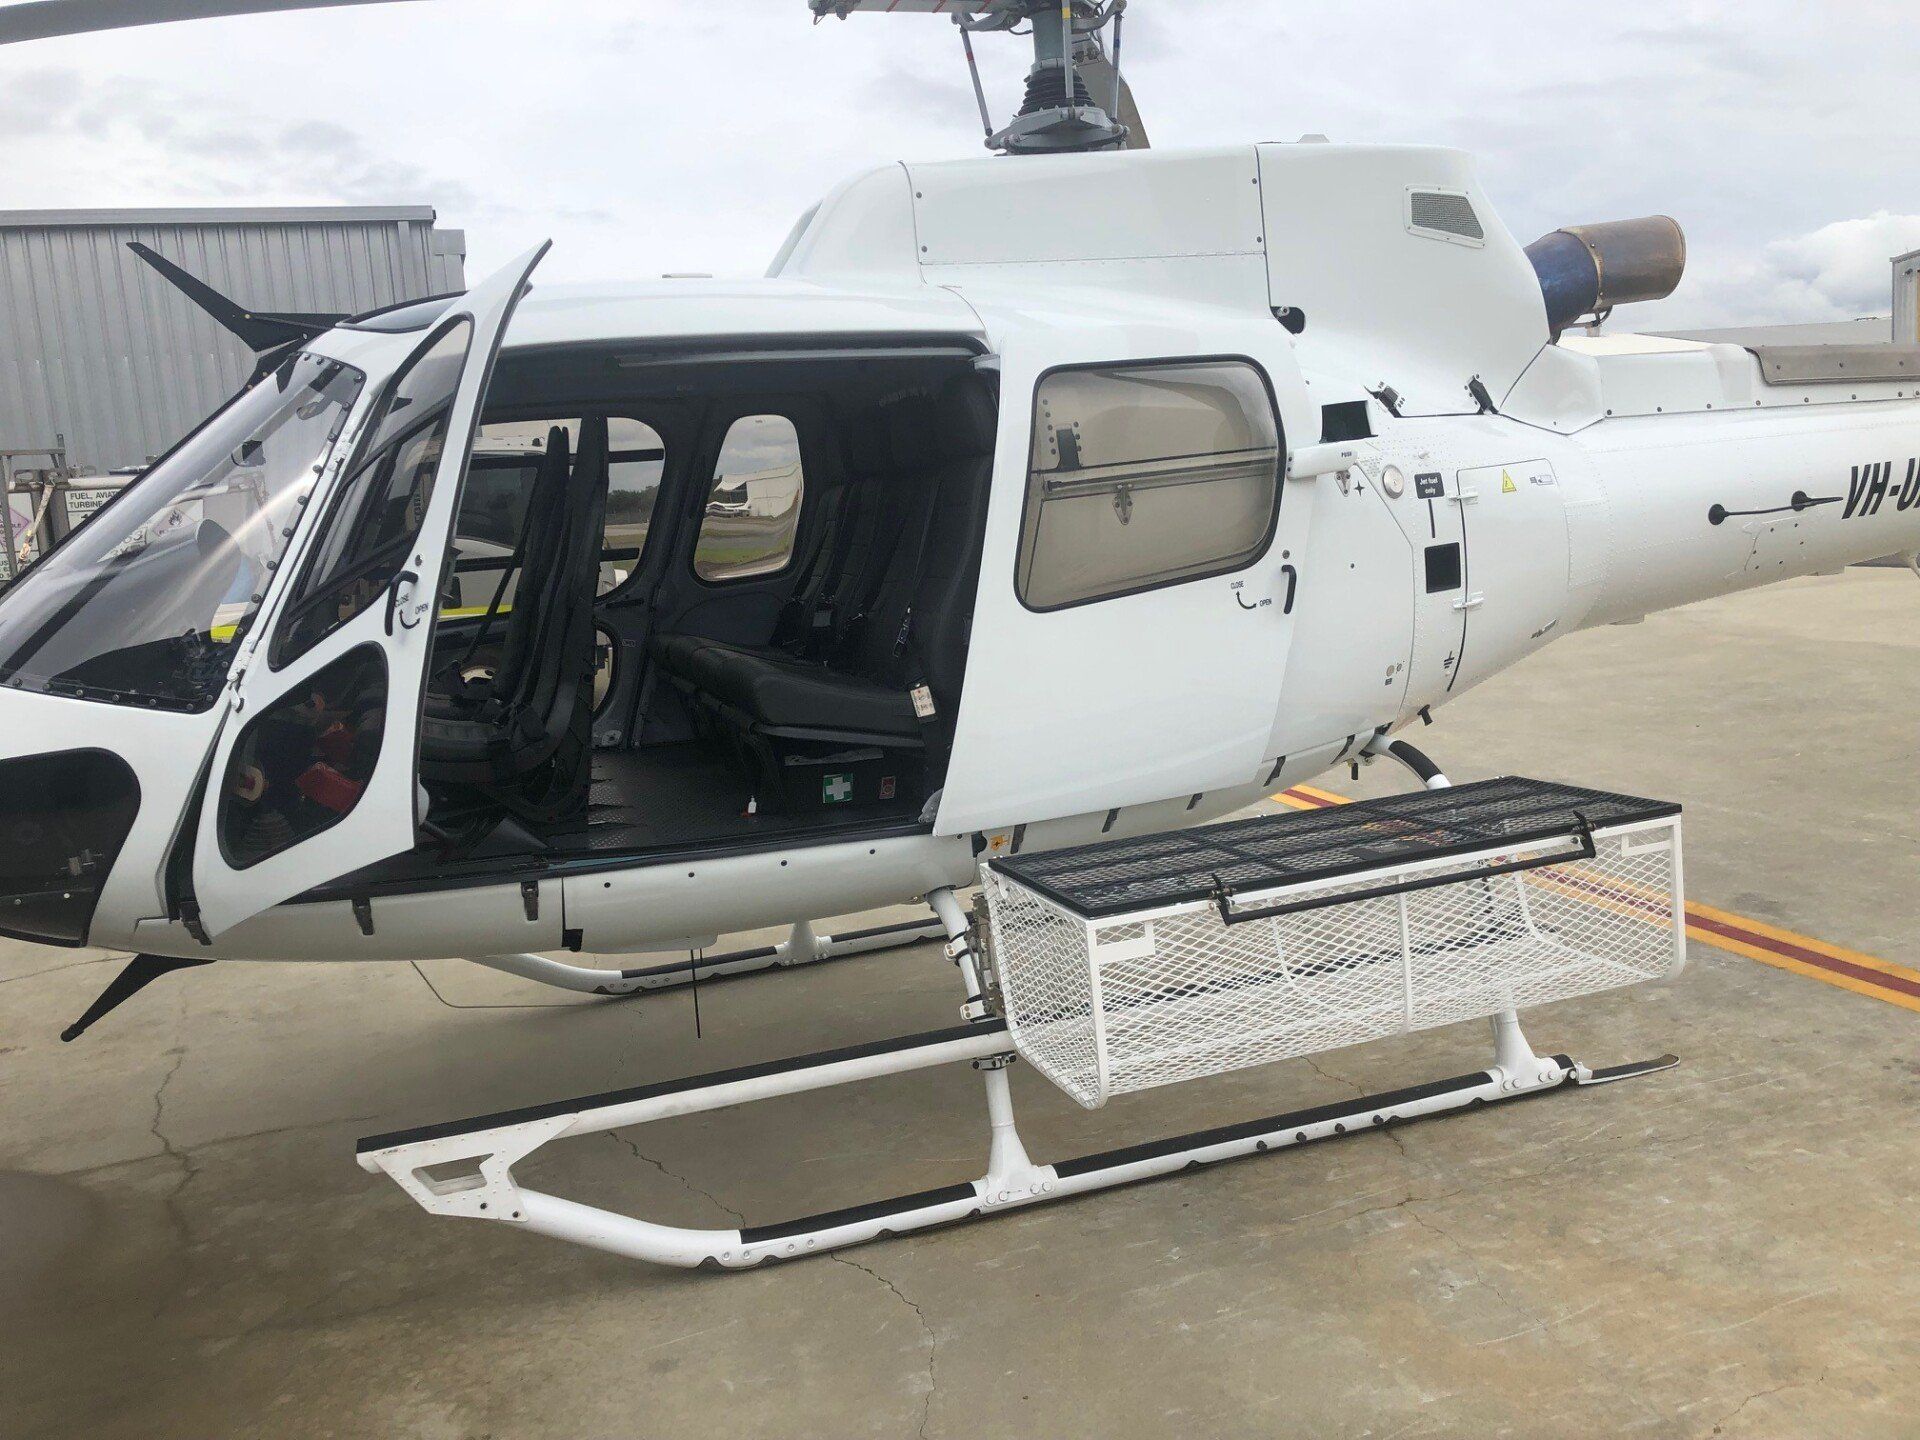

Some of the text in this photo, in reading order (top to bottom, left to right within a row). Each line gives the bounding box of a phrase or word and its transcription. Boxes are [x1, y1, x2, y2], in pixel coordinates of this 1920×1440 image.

[1841, 457, 1920, 519] VH-U
[70, 492, 93, 500] FUEL,
[1230, 580, 1244, 590] CLOSE
[1259, 598, 1272, 607] OPEN
[415, 602, 429, 615] OPEN
